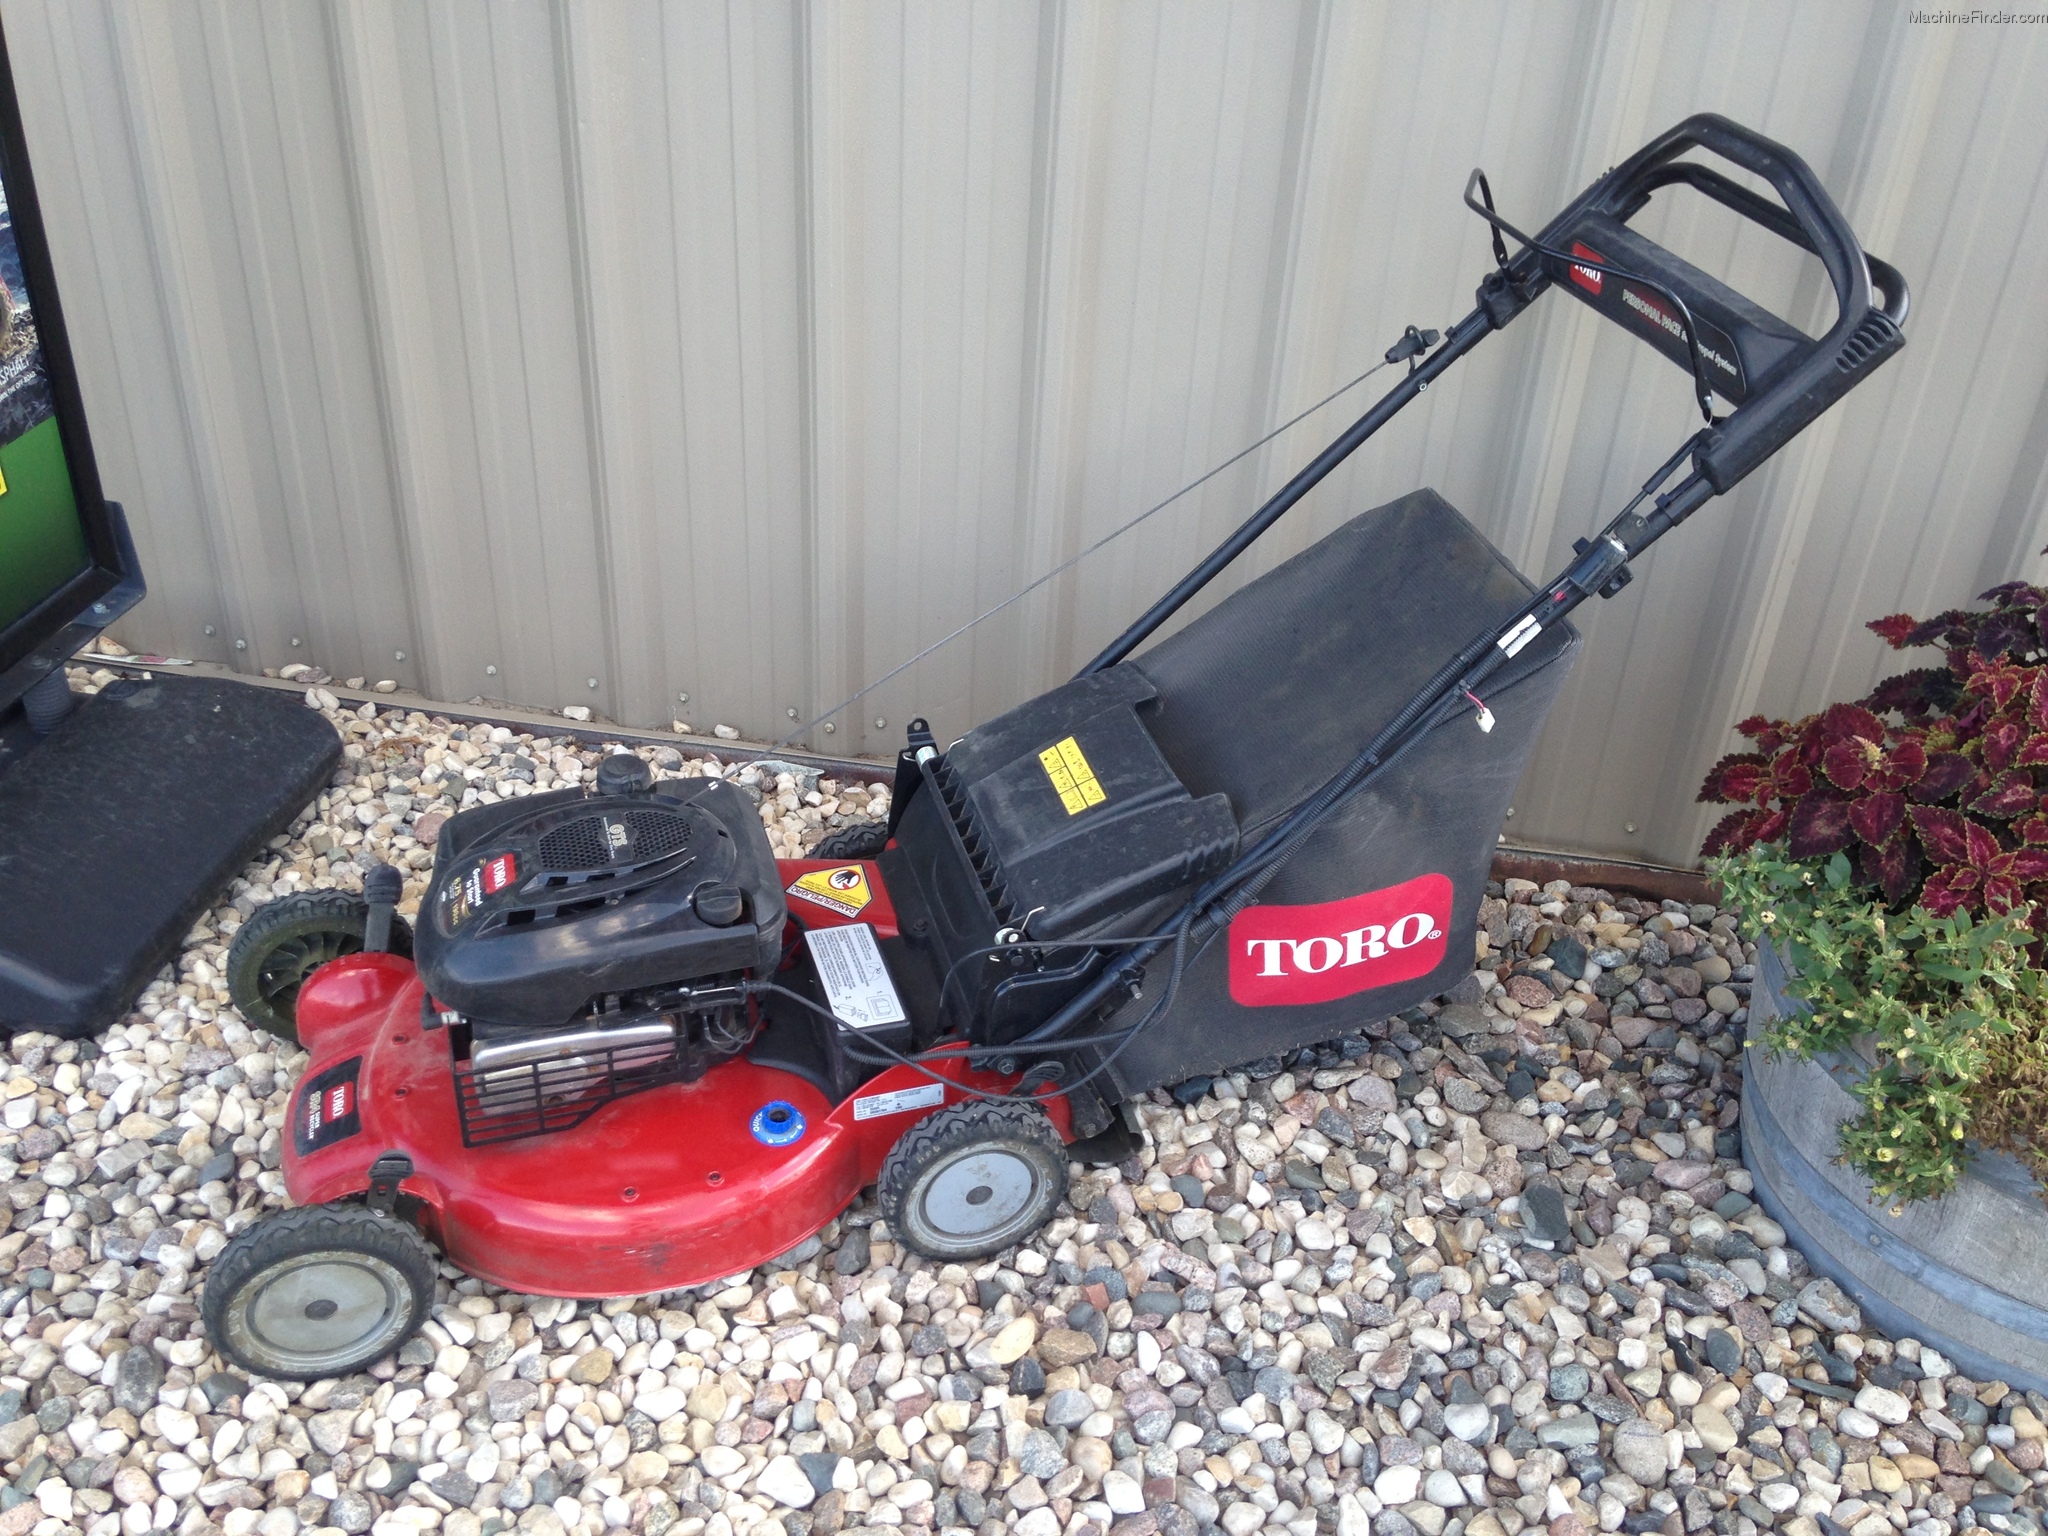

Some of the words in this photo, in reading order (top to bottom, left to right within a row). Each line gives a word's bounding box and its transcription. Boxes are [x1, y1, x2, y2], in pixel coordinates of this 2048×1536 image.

[1622, 288, 1661, 325] PERSONAL
[1660, 311, 1682, 338] PACE
[609, 823, 628, 847] GTS
[472, 867, 484, 907] Guaranteed
[493, 857, 508, 889] TORO
[466, 887, 476, 906] Start
[332, 1086, 345, 1119] TORO
